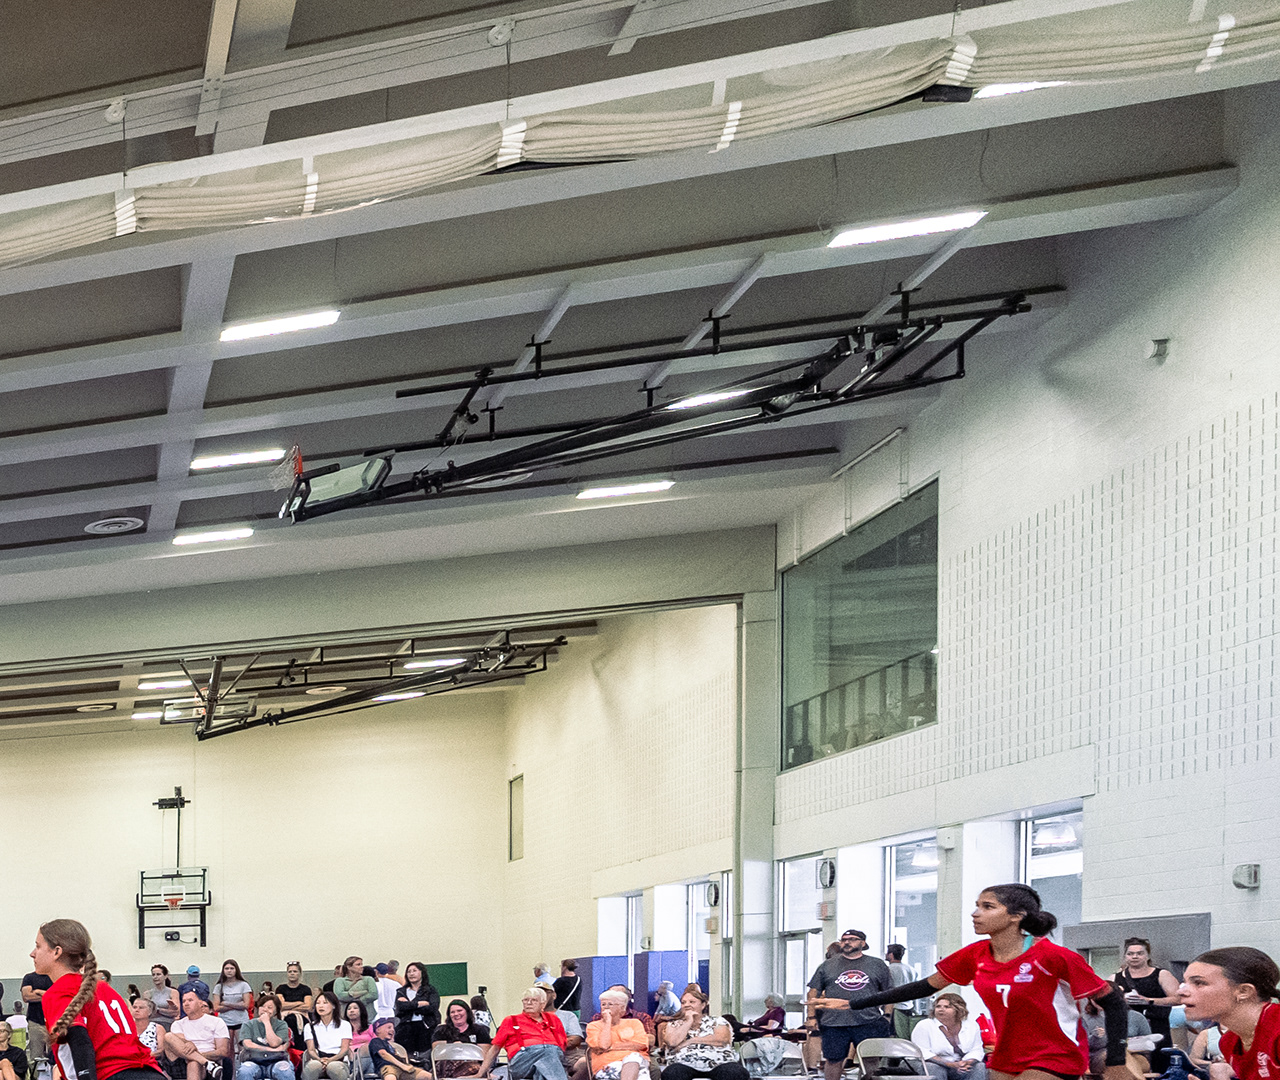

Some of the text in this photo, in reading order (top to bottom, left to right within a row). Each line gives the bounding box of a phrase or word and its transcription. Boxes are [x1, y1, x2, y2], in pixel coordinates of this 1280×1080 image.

[834, 974, 870, 984] Rebels
[995, 984, 1011, 1009] 7
[98, 999, 133, 1035] 11
